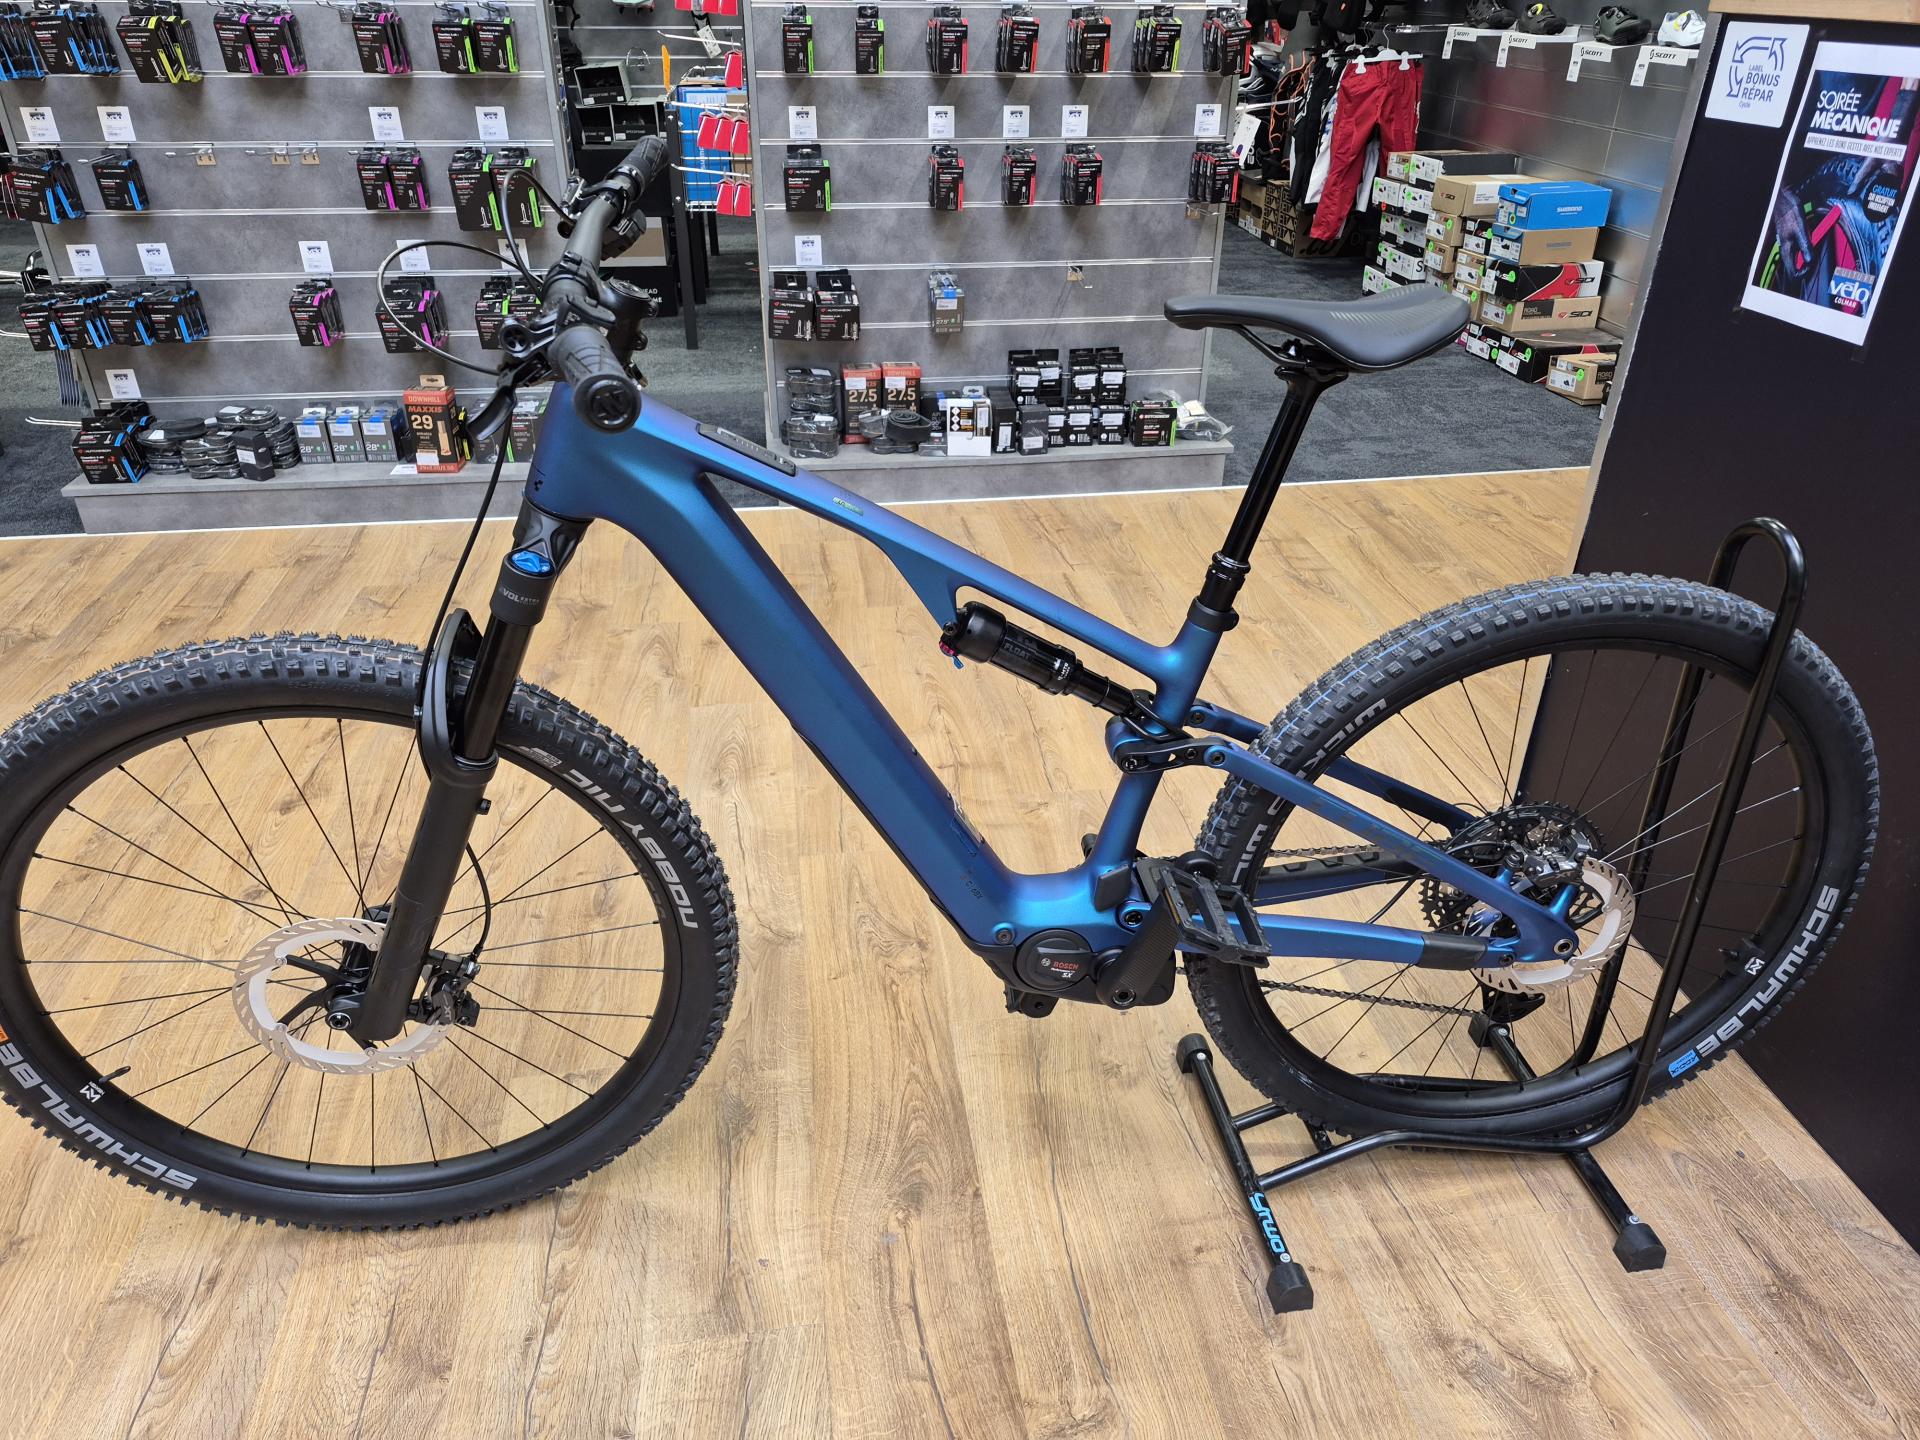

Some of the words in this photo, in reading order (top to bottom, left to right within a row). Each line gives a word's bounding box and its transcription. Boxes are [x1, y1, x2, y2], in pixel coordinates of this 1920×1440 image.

[1584, 49, 1603, 57] SCOTT
[1655, 51, 1677, 60] SCOTT
[1748, 64, 1764, 72] LABEL
[1746, 72, 1781, 87] BONUS
[1741, 86, 1774, 103] RÉPAR
[1816, 87, 1862, 112] SOIRÉE
[1810, 107, 1902, 139] MÉCANIQUE
[1872, 184, 1897, 197] GRATUIT
[1834, 296, 1858, 308] COLMAR
[1568, 310, 1593, 318] SIDI
[848, 388, 878, 403] 27.5
[887, 387, 916, 401] 27.5
[408, 405, 443, 413] MAXXIS
[411, 414, 433, 430] 29
[563, 768, 626, 814] NIC
[620, 820, 699, 929] NOBBY
[1053, 960, 1080, 970] BOSCH
[1696, 884, 1841, 1058] SCHWALBE
[0, 1041, 199, 1191] SCHWALBE
